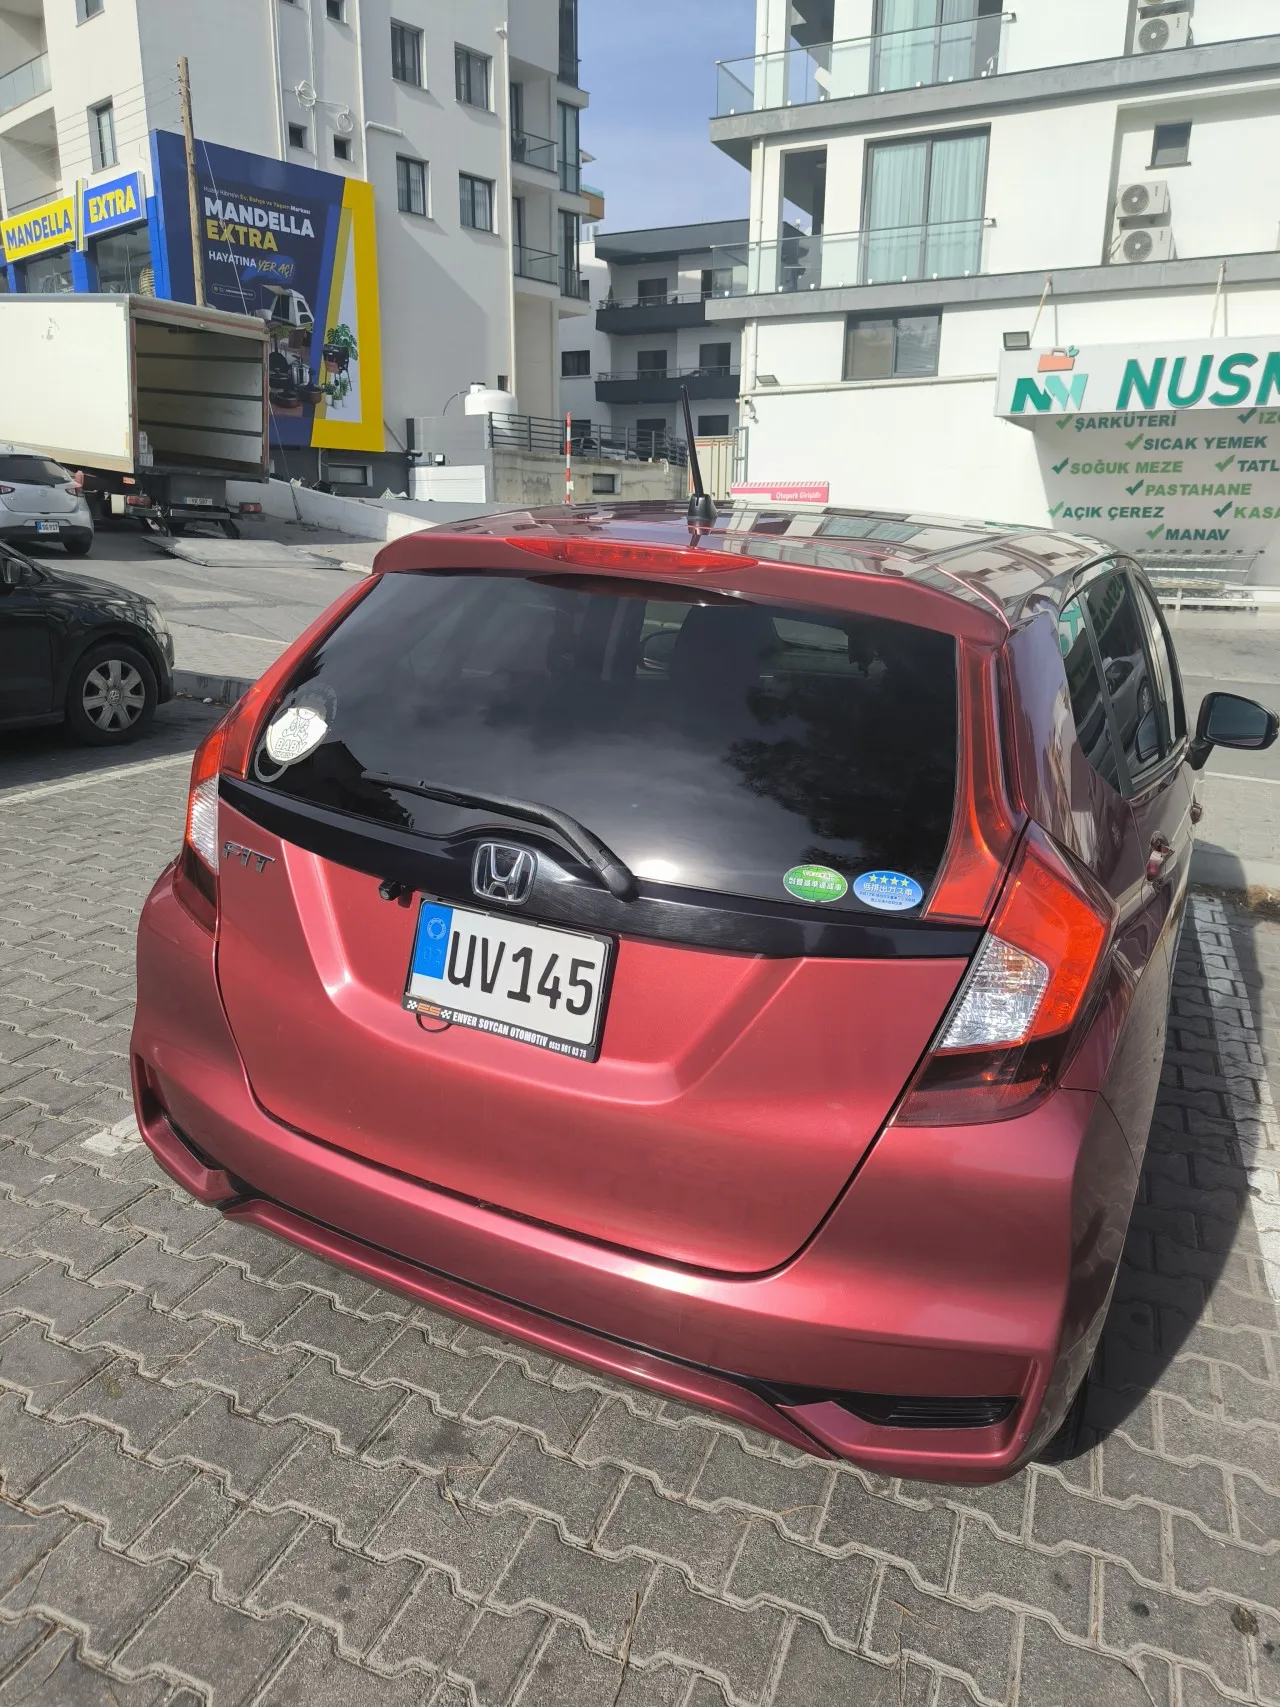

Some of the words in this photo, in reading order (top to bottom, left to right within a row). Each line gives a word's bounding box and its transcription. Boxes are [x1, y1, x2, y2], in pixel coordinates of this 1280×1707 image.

[88, 185, 137, 224] EXTRA
[5, 208, 73, 251] MANDELLA
[204, 197, 315, 239] MANDELLA
[206, 219, 278, 252] EXTRA
[208, 250, 257, 268] HAYATINA
[257, 259, 280, 276] YER
[278, 263, 294, 278] AÇ!
[1075, 411, 1177, 432] ŞARKÜTERİ
[1143, 437, 1198, 451] SICAK
[1203, 436, 1268, 450] YEMEK
[1069, 459, 1130, 475] SOĞUK
[1135, 460, 1184, 474] MEZE
[775, 491, 798, 501] Otopark
[1144, 483, 1252, 497] PASTAHANE
[1062, 507, 1103, 521] AÇIK
[1107, 506, 1165, 521] ÇEREZ
[1165, 528, 1230, 541] MANAV
[275, 738, 308, 753] BABY
[223, 840, 276, 873] FIT
[447, 930, 596, 1016] UV145
[452, 1011, 478, 1027] ENVER
[478, 1018, 509, 1036] SOYCAN
